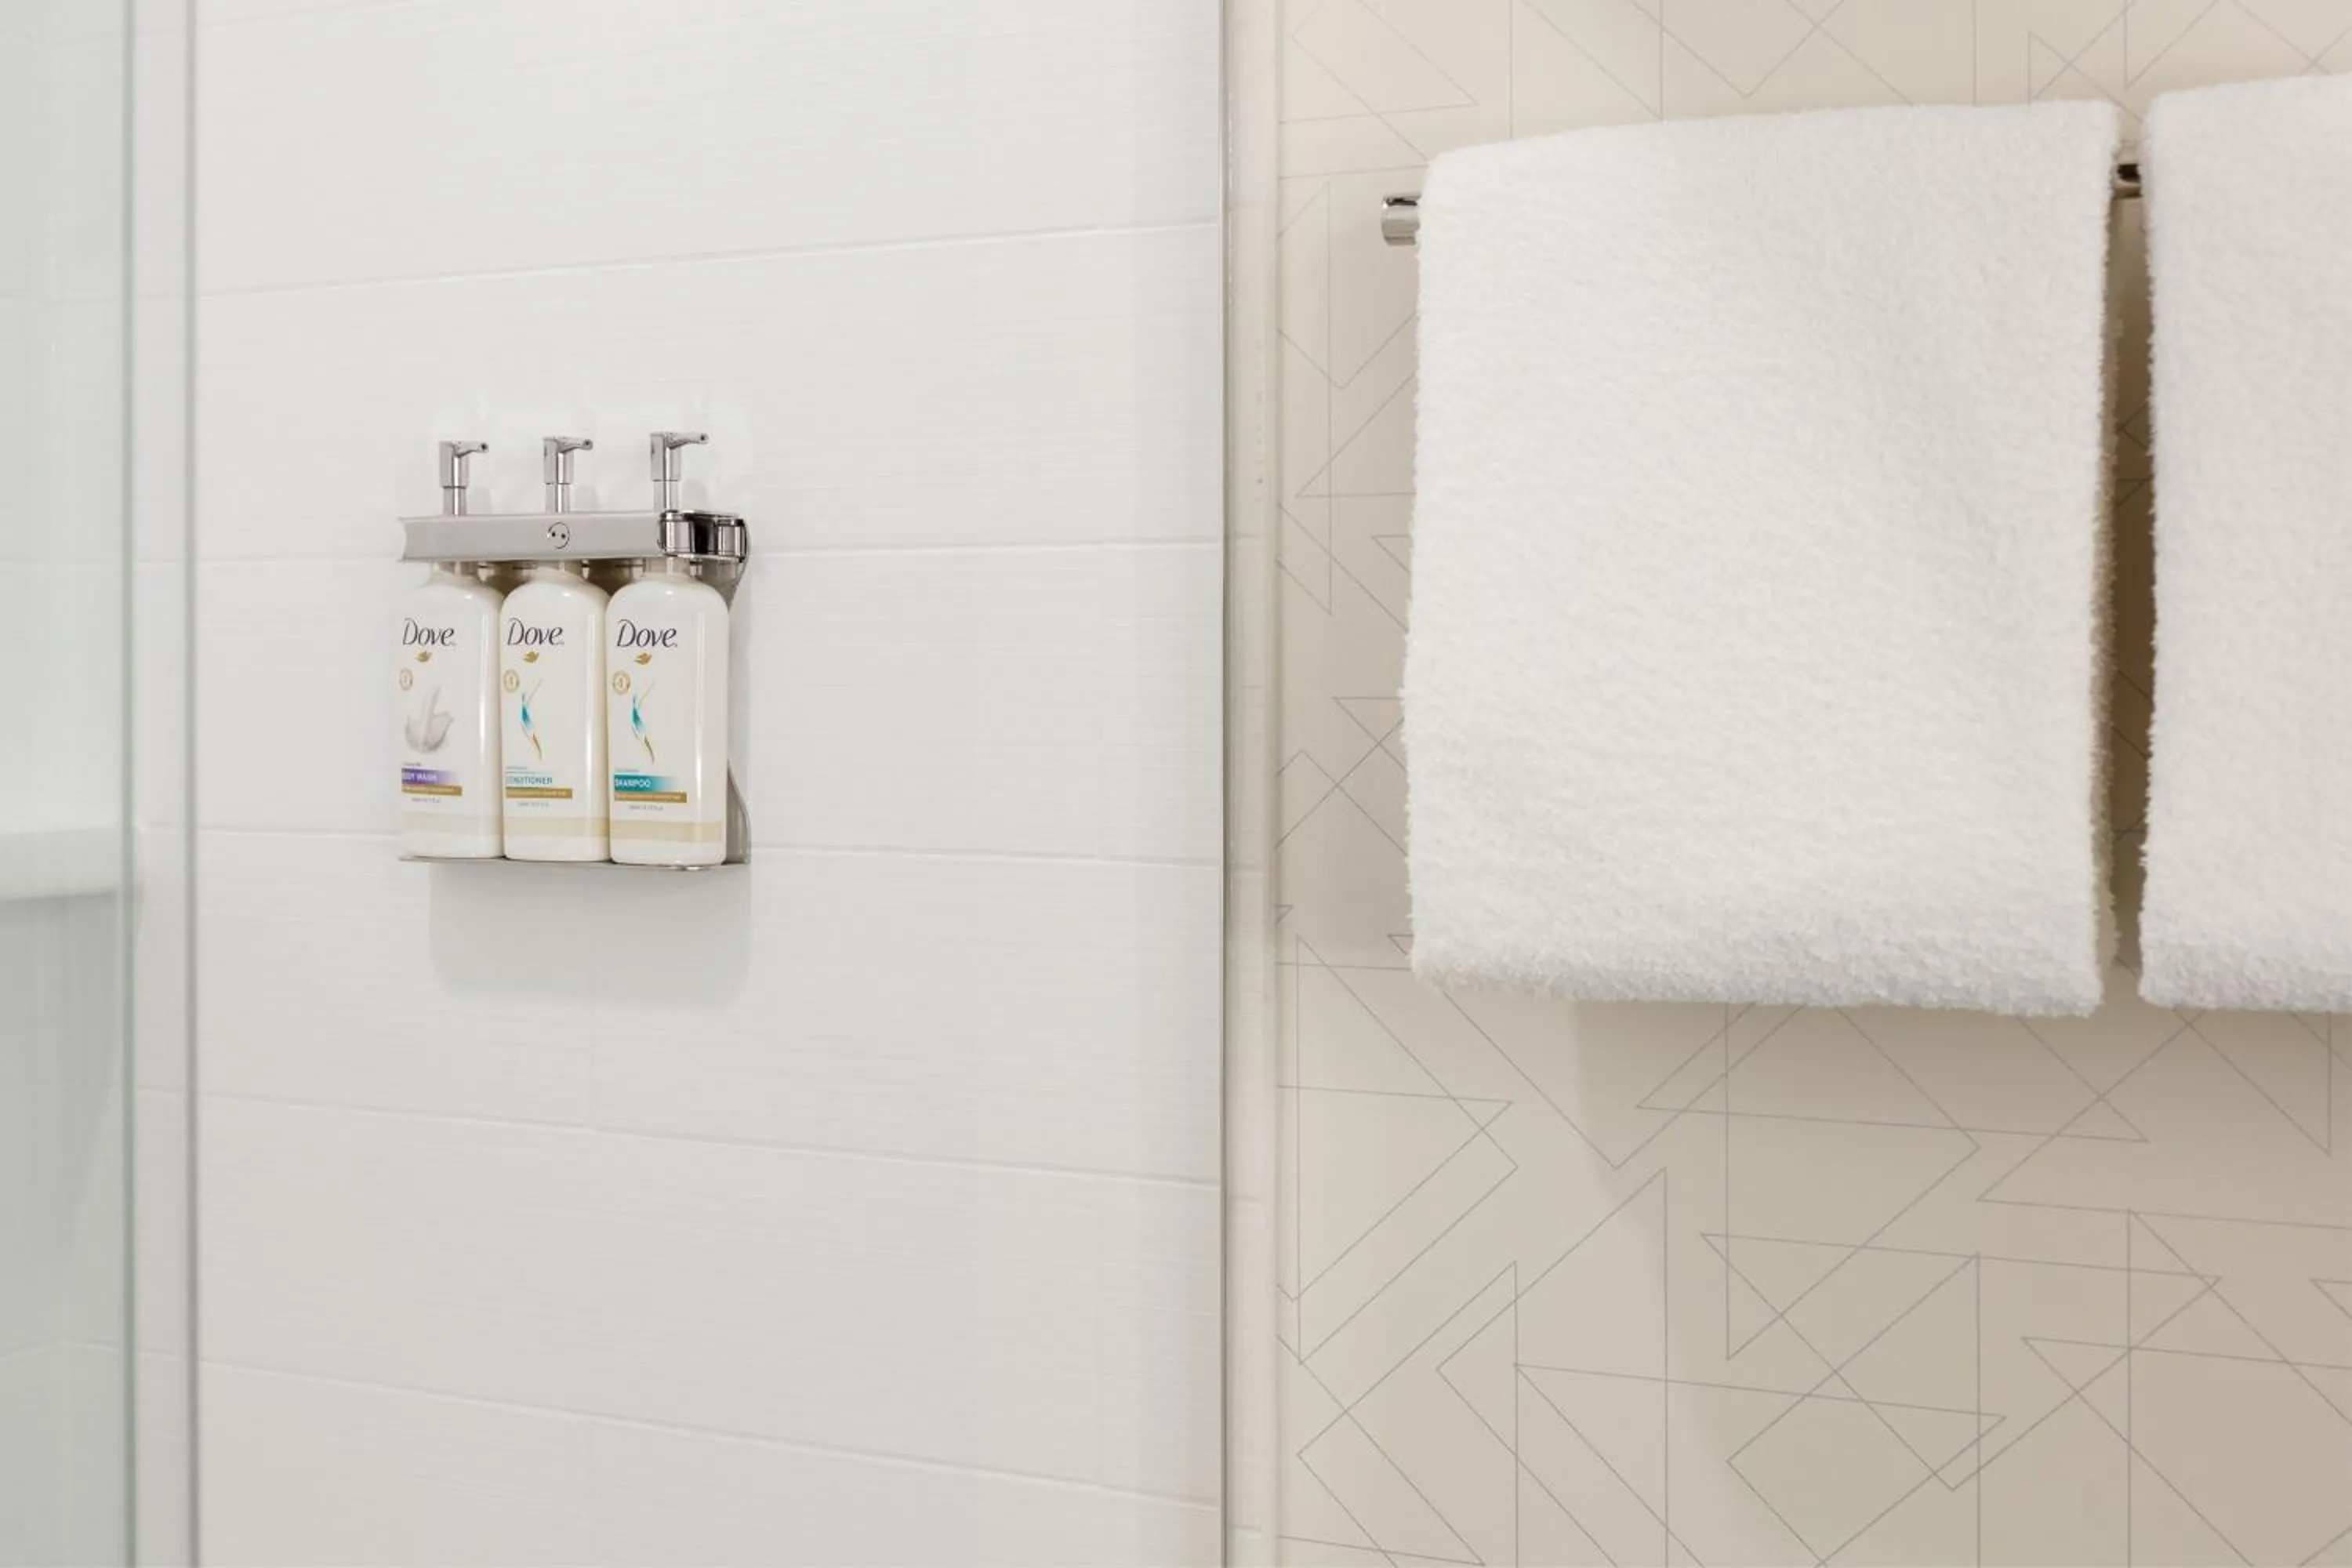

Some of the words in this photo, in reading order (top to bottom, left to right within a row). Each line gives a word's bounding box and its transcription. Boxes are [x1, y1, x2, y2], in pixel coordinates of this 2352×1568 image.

[402, 617, 455, 646] Dove
[507, 617, 564, 647] Dove
[616, 618, 677, 648] Dove
[615, 777, 652, 788] SHAMPOO
